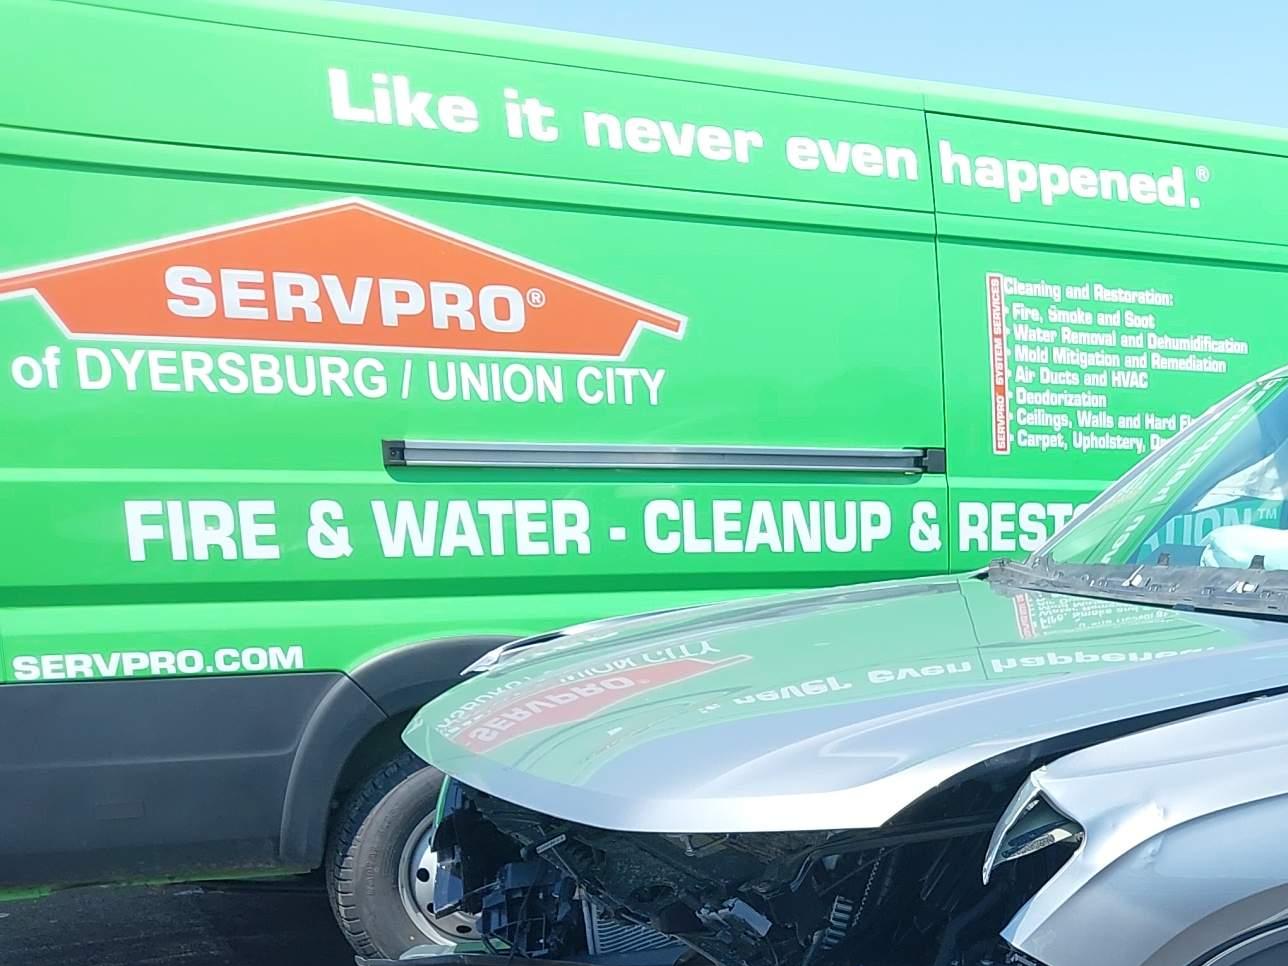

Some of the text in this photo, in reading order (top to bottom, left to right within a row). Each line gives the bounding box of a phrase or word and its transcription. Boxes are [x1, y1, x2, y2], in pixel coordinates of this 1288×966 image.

[326, 65, 481, 134] Like
[502, 86, 559, 142] it
[583, 111, 764, 165] never
[786, 136, 919, 182] even
[1003, 276, 1174, 305] Cleaning and Restoration:
[990, 278, 1002, 335] SERVICES
[1012, 303, 1156, 329] Fire, Smoke and Soot
[1013, 324, 1249, 355] Water Removal and Dehumidification
[1014, 346, 1227, 373] Mold Mitigation and Remediation
[11, 345, 666, 406] of DYERSBURG / UNION CITY
[1014, 365, 1149, 389] Air Ducts and HVAC
[1015, 386, 1107, 408] Deodorization
[1016, 408, 1073, 430] Ceilings,
[1077, 409, 1114, 429] Walls
[1118, 412, 1141, 430] and
[1145, 413, 1176, 431] Hard
[1016, 429, 1068, 452] Carpet,
[1072, 430, 1146, 455] Upholstery,
[124, 500, 280, 561] FIRE
[307, 499, 353, 559] &
[371, 499, 591, 558] WATER
[644, 499, 891, 554] CLEANUP
[909, 500, 942, 552] &
[12, 645, 304, 681] SERVPRO.COM
